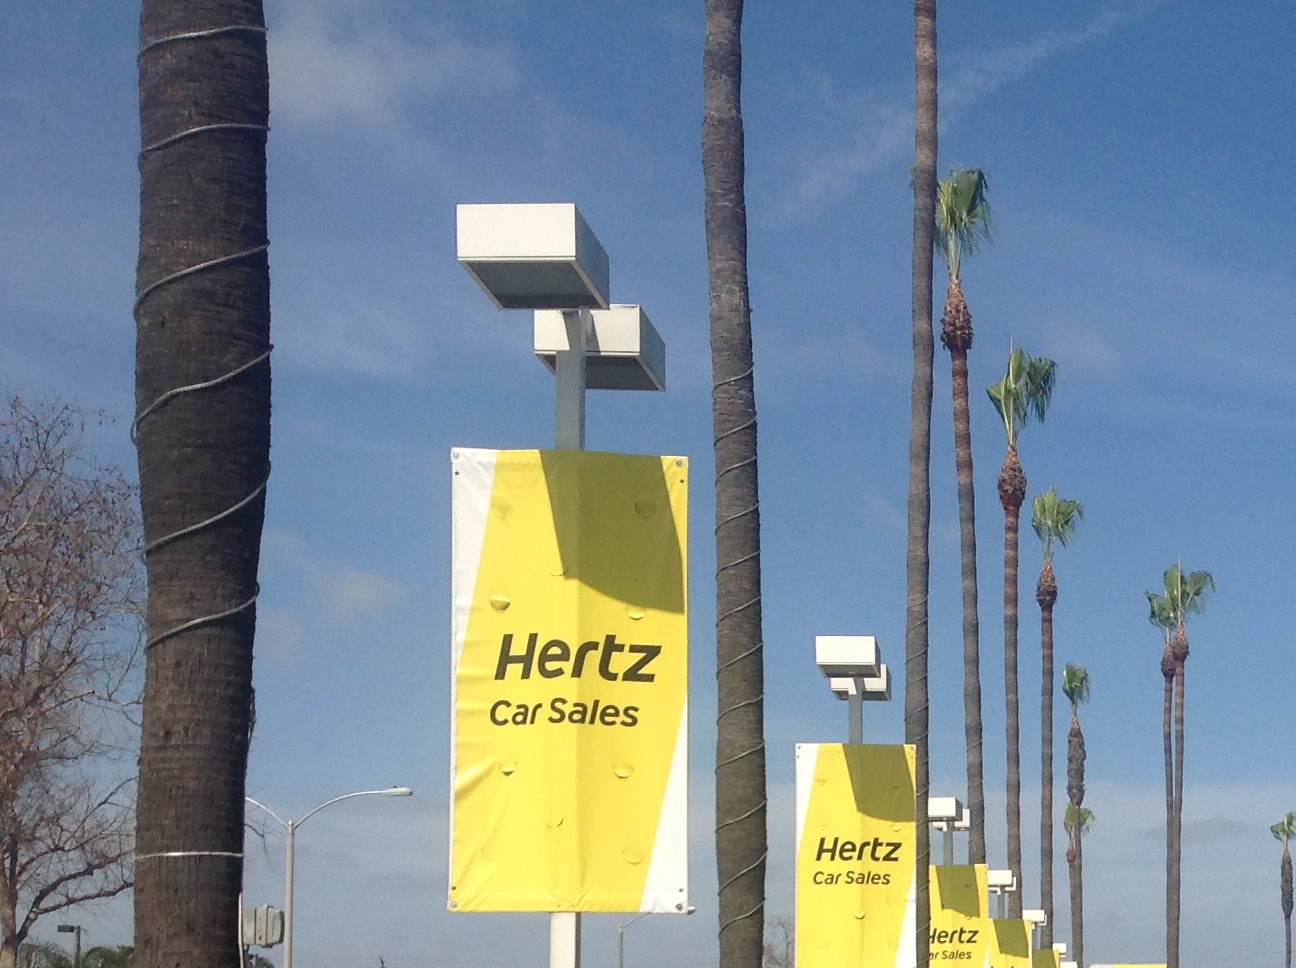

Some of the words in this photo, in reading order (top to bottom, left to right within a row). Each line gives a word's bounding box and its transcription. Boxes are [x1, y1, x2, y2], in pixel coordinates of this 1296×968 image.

[494, 632, 662, 682] Hertz
[489, 699, 543, 726] Car
[548, 697, 640, 727] Sales
[815, 836, 903, 862] Hertz
[813, 871, 842, 885] Car
[844, 870, 891, 885] Sales
[941, 949, 972, 960] Sales
